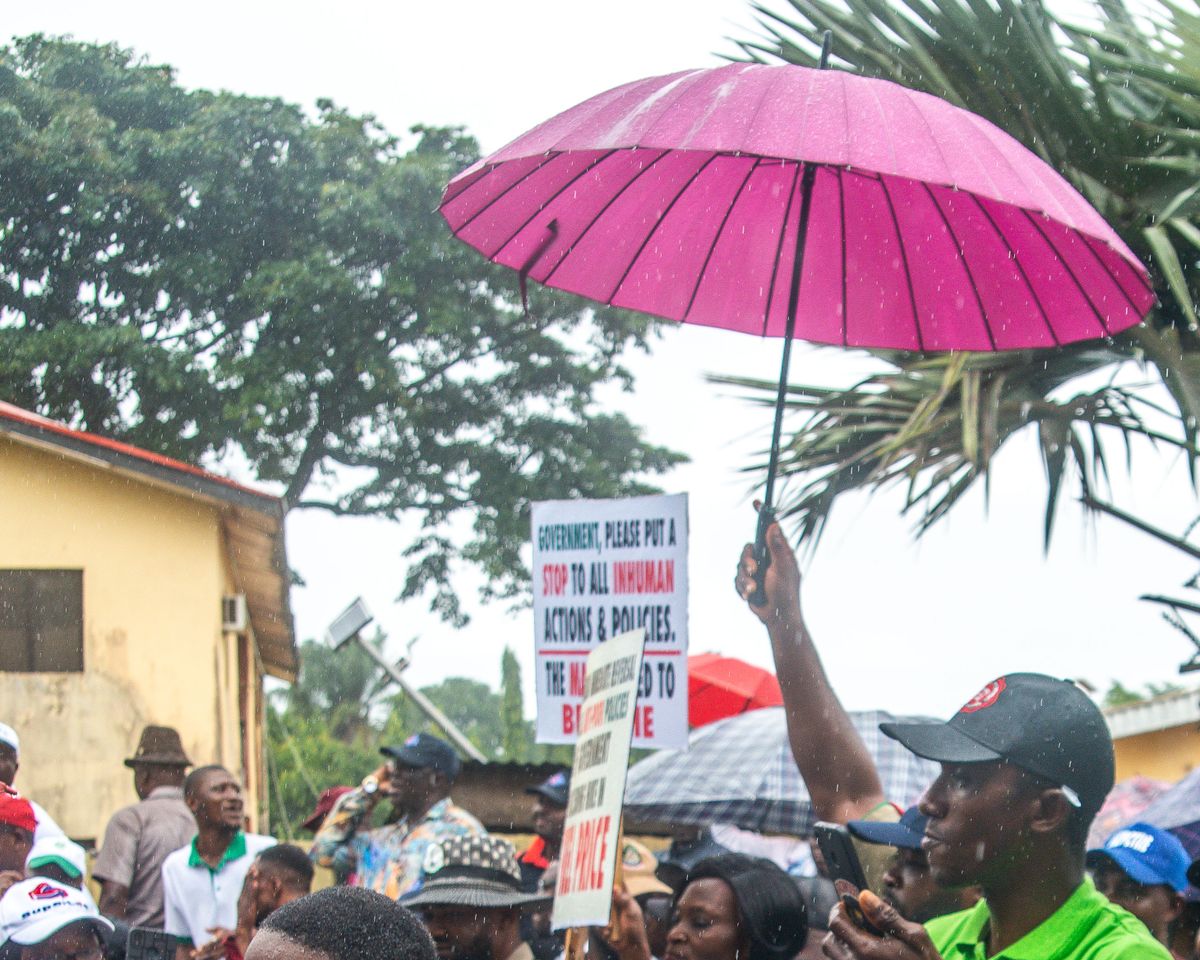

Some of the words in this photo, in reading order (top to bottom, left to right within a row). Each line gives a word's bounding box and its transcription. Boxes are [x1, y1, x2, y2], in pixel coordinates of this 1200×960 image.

[538, 521, 602, 554] GOVERNMENT,
[605, 519, 641, 549] PLEASE
[644, 518, 665, 547] PUT
[669, 517, 676, 546] A
[543, 563, 568, 597] STOP
[571, 561, 586, 594] TO
[590, 561, 609, 594] ALL
[613, 559, 675, 594] INHUMAN
[544, 605, 593, 643] ACTIONS
[597, 605, 607, 642] &
[545, 660, 566, 697] THE
[657, 661, 676, 699] TO
[573, 815, 611, 893] PRICE
